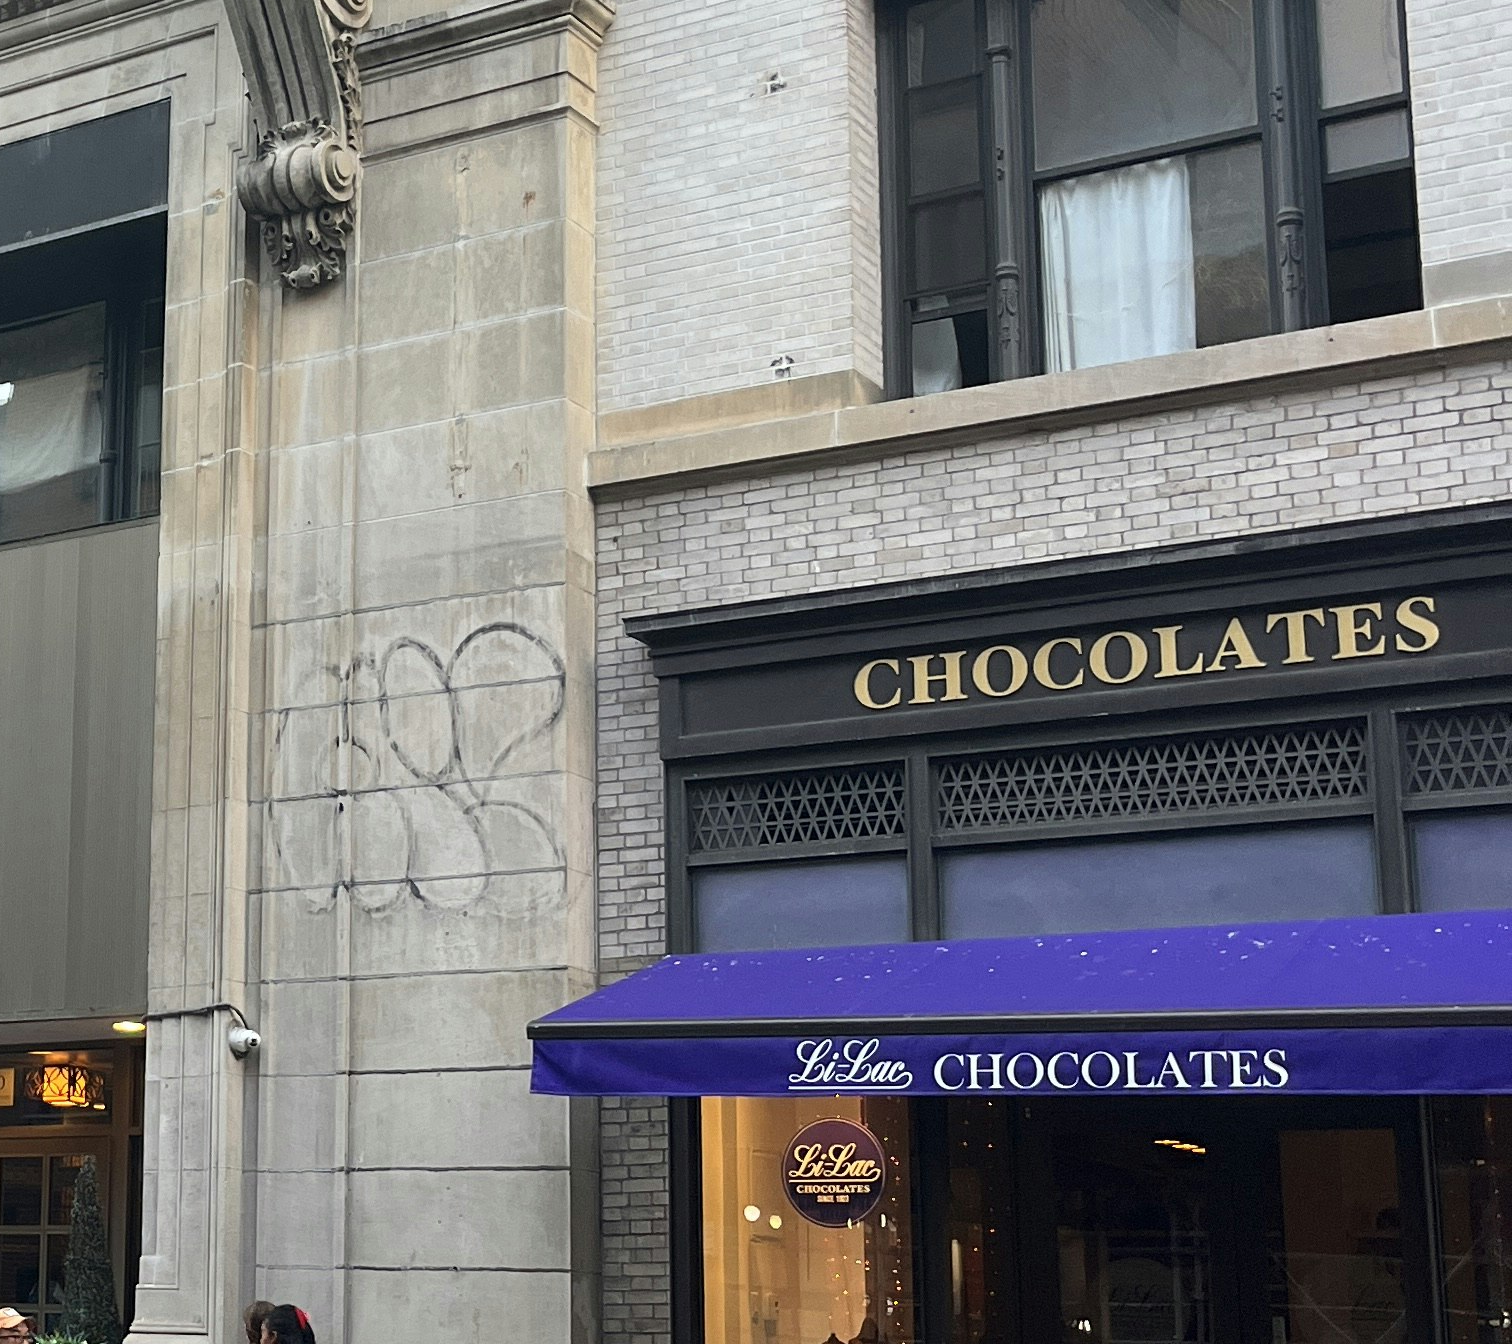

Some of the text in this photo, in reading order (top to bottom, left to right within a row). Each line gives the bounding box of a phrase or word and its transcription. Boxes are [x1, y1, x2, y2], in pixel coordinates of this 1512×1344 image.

[853, 596, 1441, 709] CHOCOLATES
[788, 1038, 1288, 1090] Li-Lac CHOCOLATES
[789, 1143, 881, 1182] Li-Lac
[796, 1185, 871, 1194] CHOCOLATES
